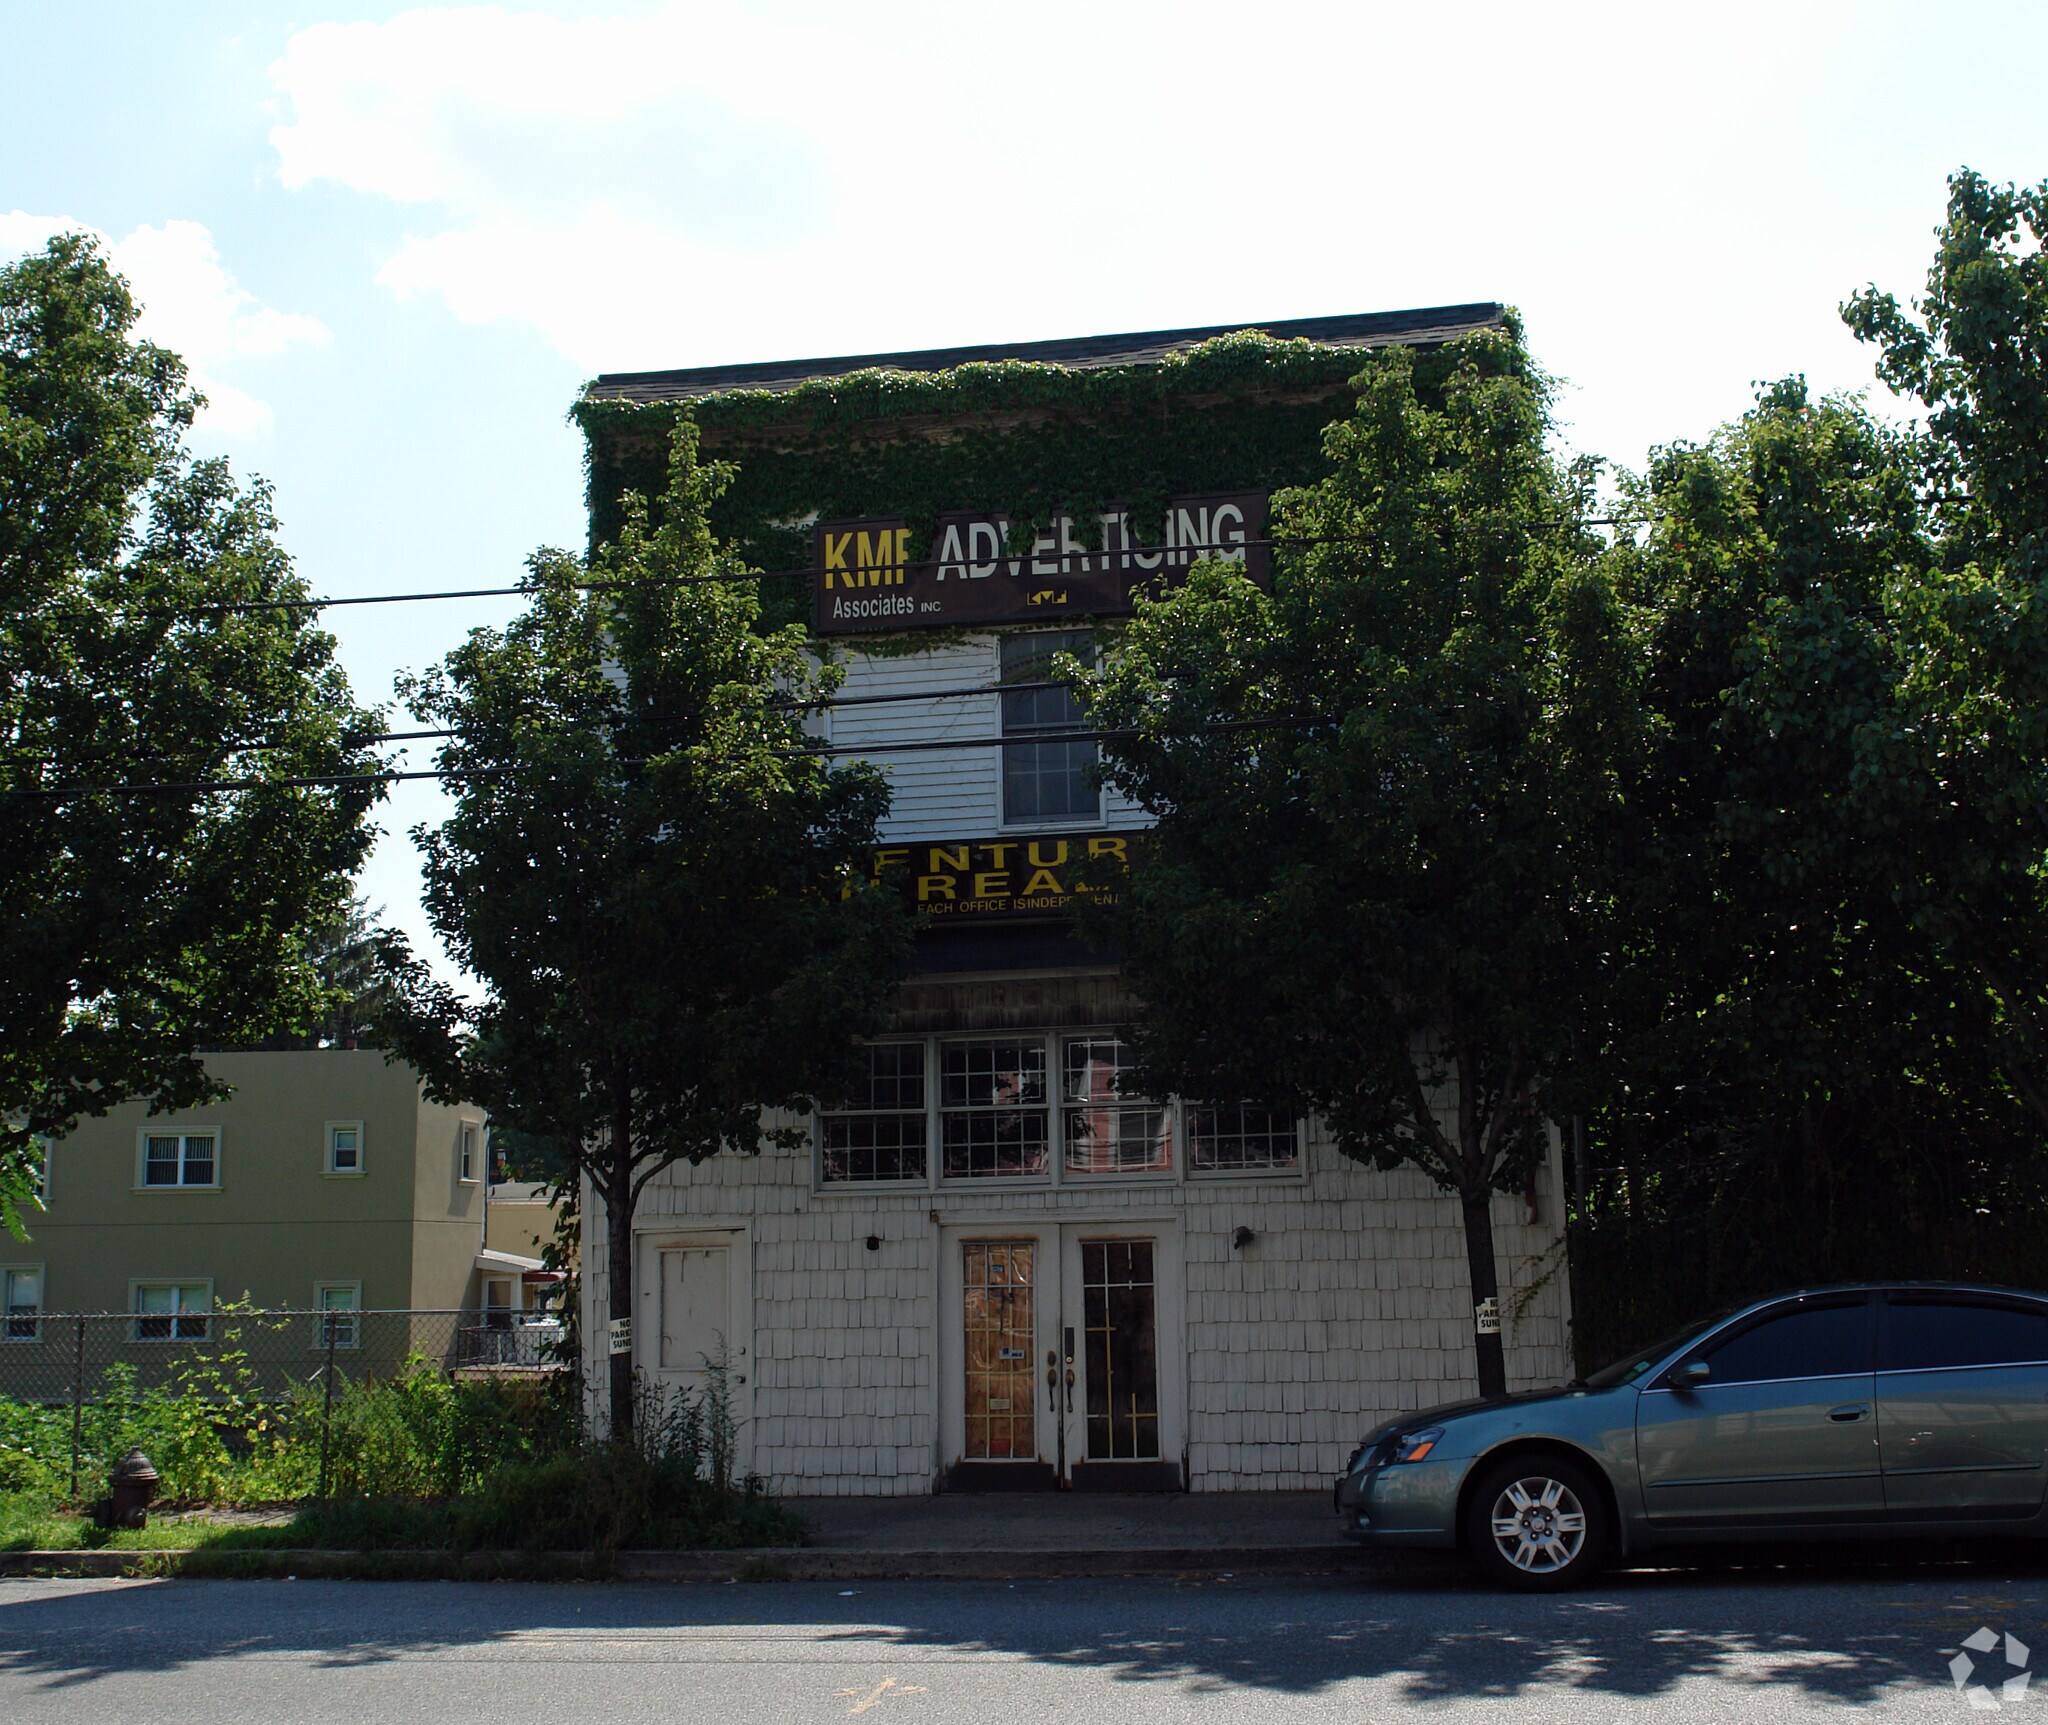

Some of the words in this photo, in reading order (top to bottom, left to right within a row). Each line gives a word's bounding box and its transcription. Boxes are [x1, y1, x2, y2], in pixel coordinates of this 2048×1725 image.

[832, 593, 914, 619] Associates
[874, 837, 1129, 876] ENTUR
[917, 868, 1110, 902] REA
[917, 902, 953, 914] EACH
[959, 899, 1007, 913] OFFICE
[619, 1319, 631, 1328] NO
